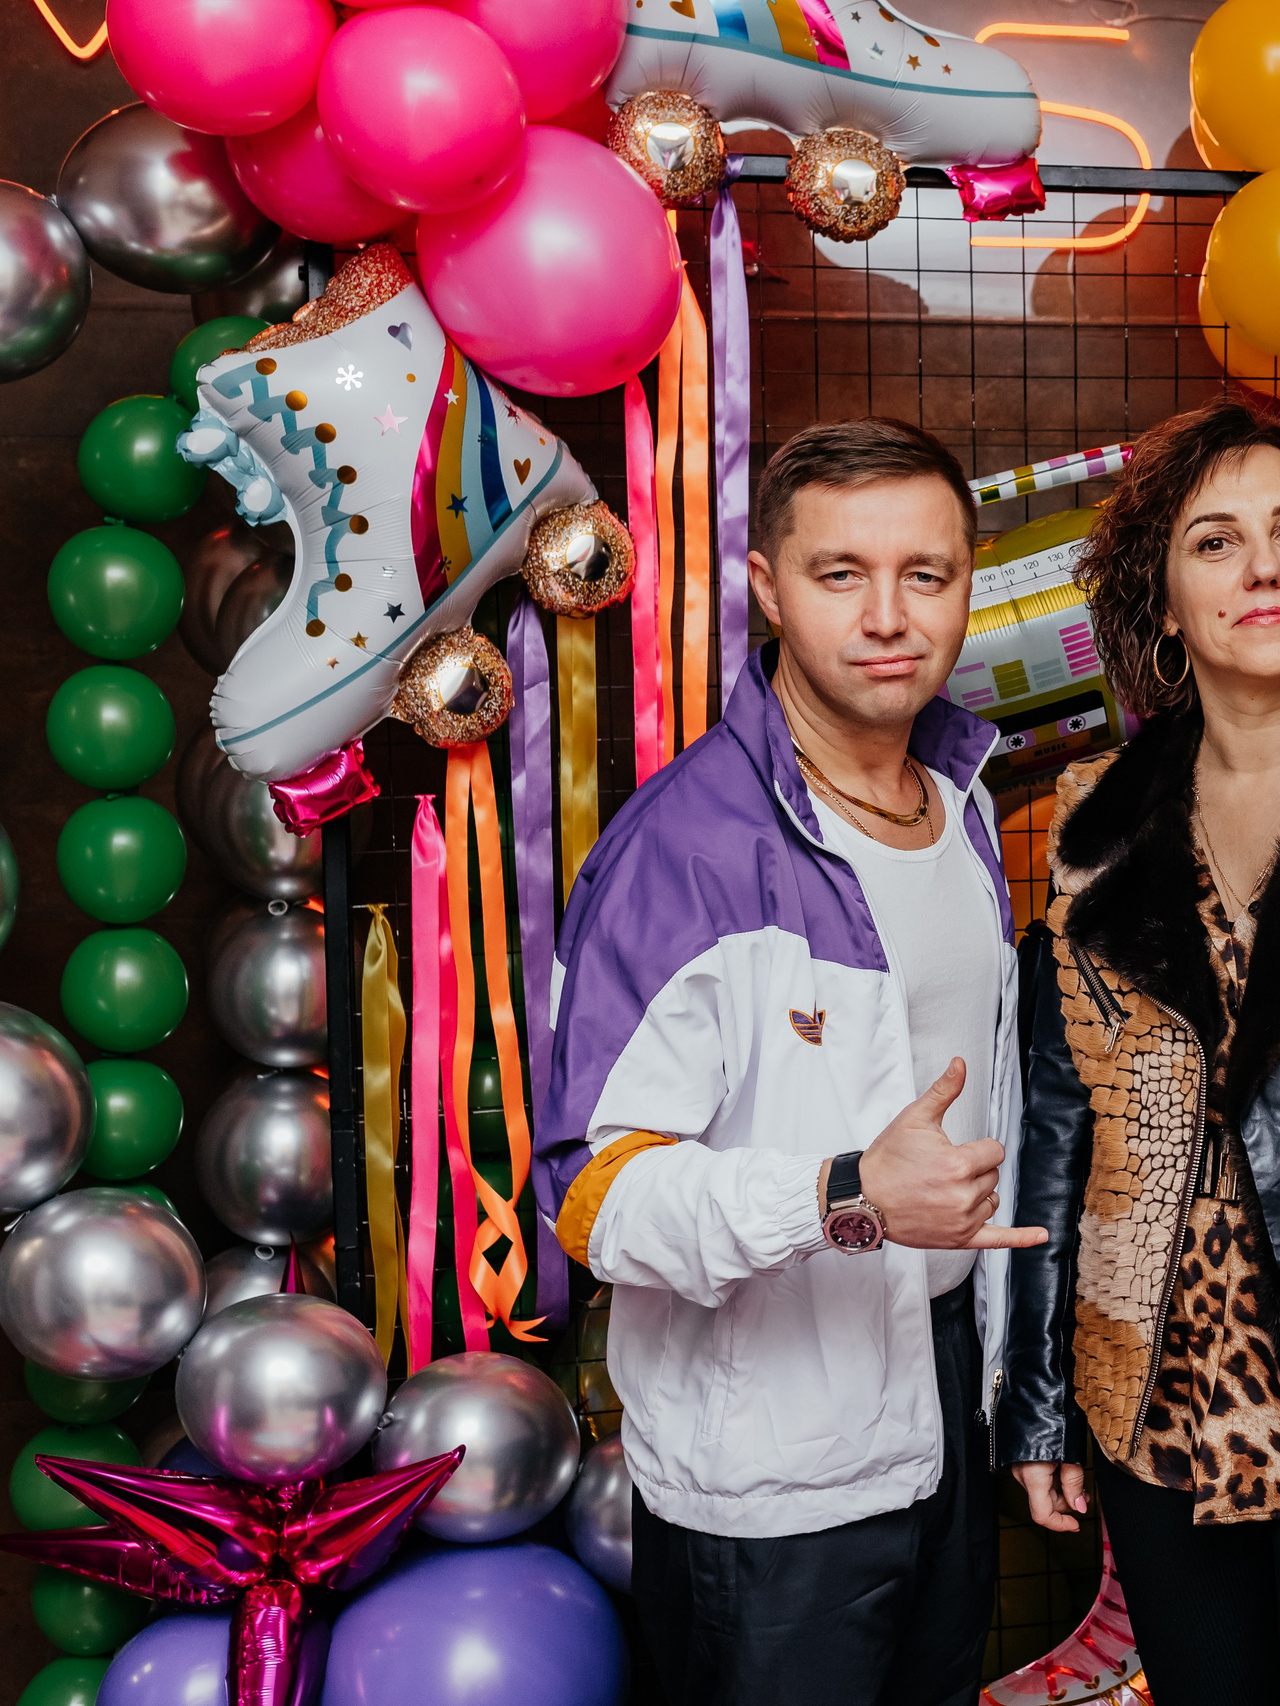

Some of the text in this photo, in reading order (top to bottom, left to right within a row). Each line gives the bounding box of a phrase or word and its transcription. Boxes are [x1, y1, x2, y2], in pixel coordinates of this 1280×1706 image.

[979, 573, 996, 583] 100
[1023, 560, 1040, 571] 120
[1047, 552, 1064, 563] 130
[1034, 742, 1067, 757] MUSIC
